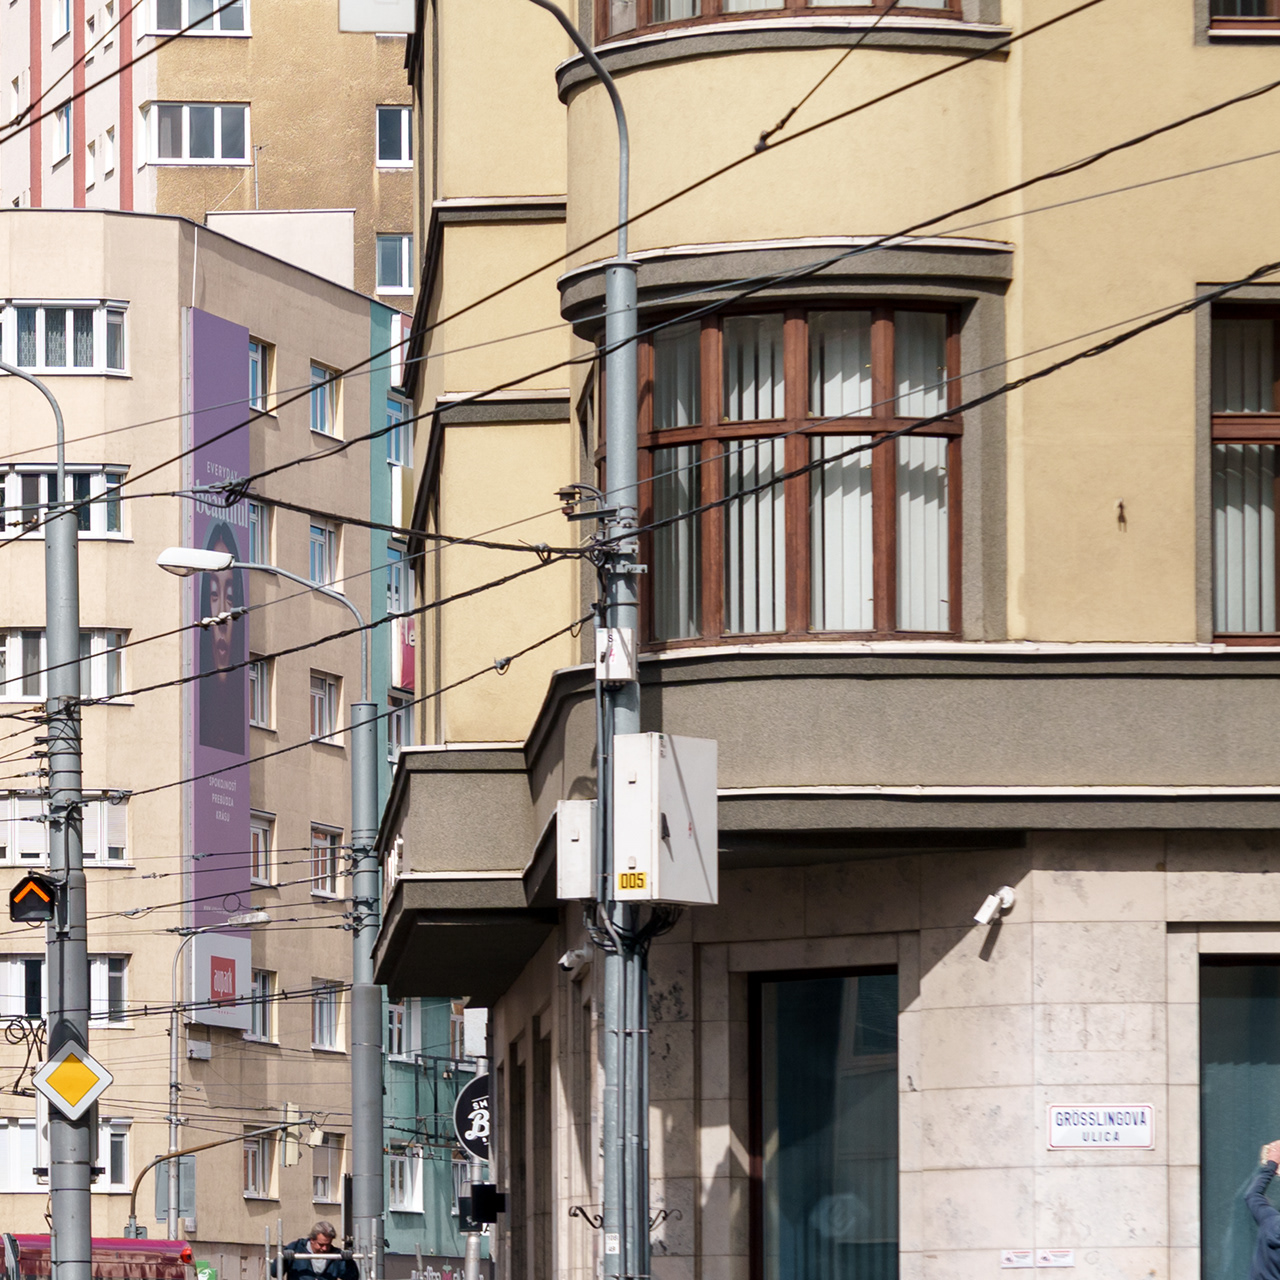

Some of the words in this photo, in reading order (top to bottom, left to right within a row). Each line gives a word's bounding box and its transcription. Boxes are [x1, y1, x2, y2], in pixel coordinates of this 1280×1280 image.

[207, 461, 237, 480] EVERYDAY
[1055, 1108, 1148, 1127] GRÖSSLINGOVÁ
[1082, 1131, 1121, 1143] ULICA
